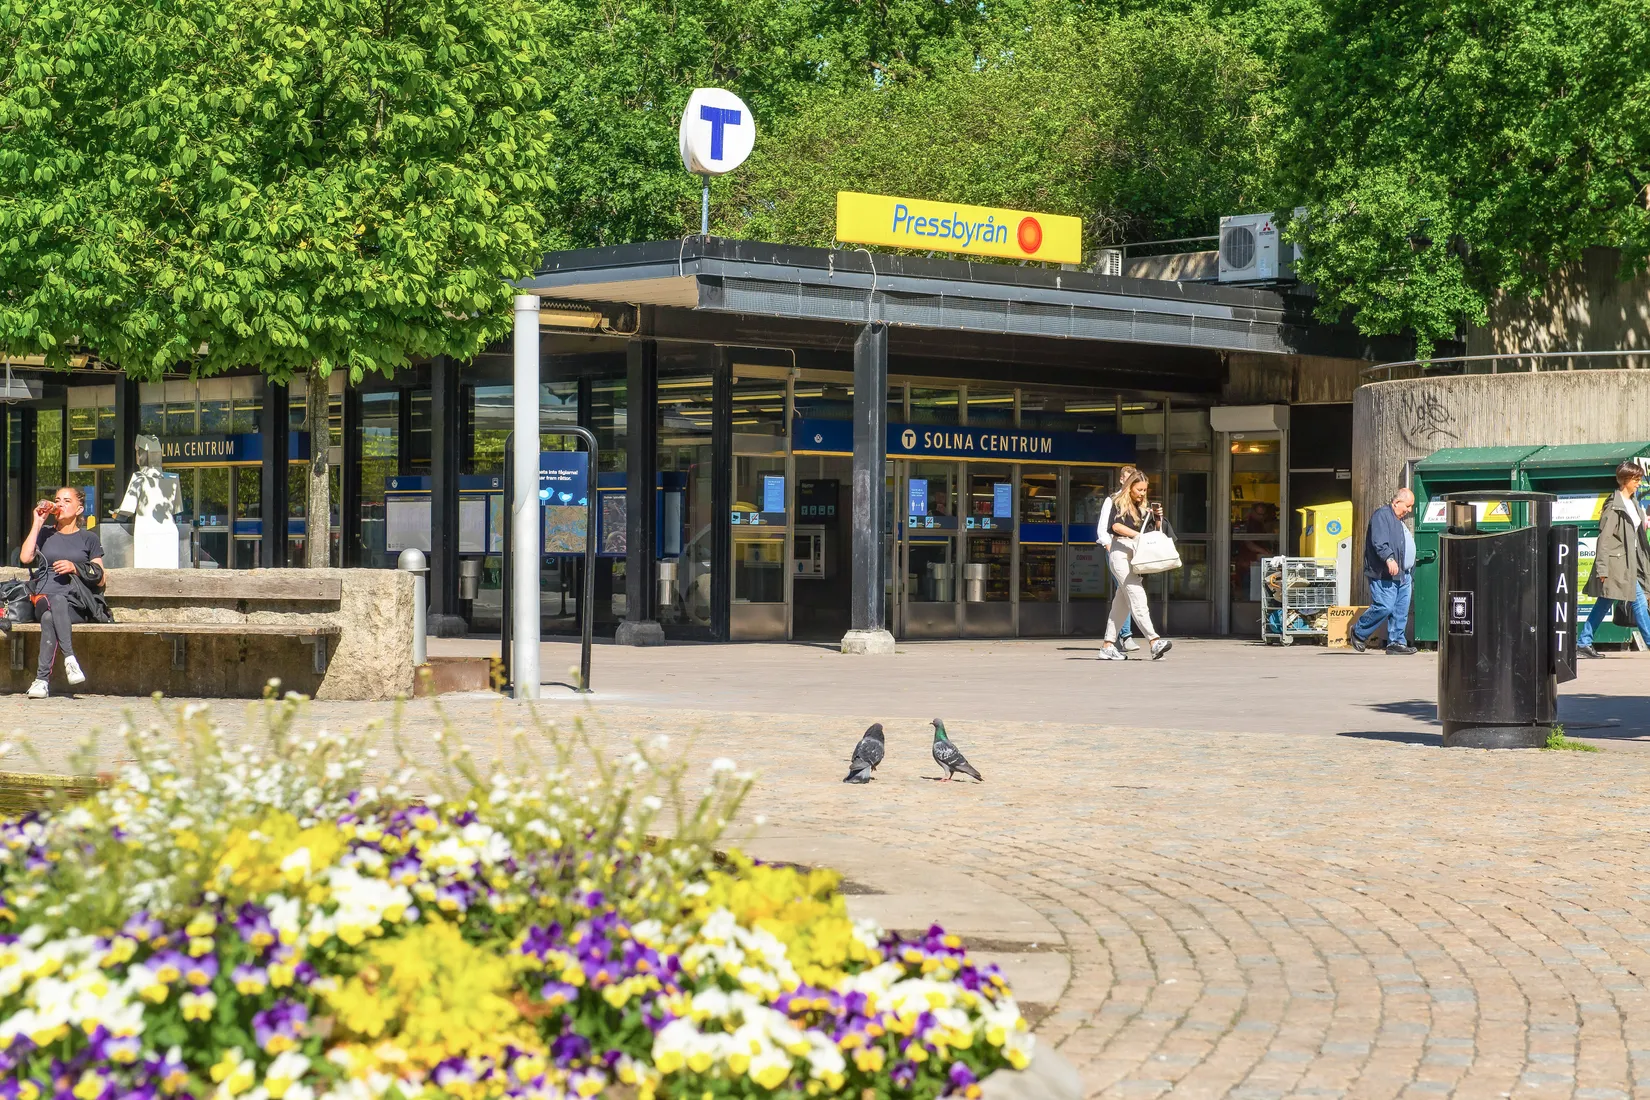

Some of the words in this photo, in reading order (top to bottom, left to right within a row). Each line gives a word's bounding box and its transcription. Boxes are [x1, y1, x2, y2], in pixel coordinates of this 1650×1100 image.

[700, 105, 741, 160] T
[893, 204, 1007, 247] Pressbyrån
[161, 443, 181, 457] LNA
[184, 441, 234, 456] CENTRUM
[924, 432, 974, 450] SOLNA
[980, 435, 1052, 453] CENTRUM
[1330, 609, 1355, 617] RUSTA
[1555, 543, 1569, 652] PANT
